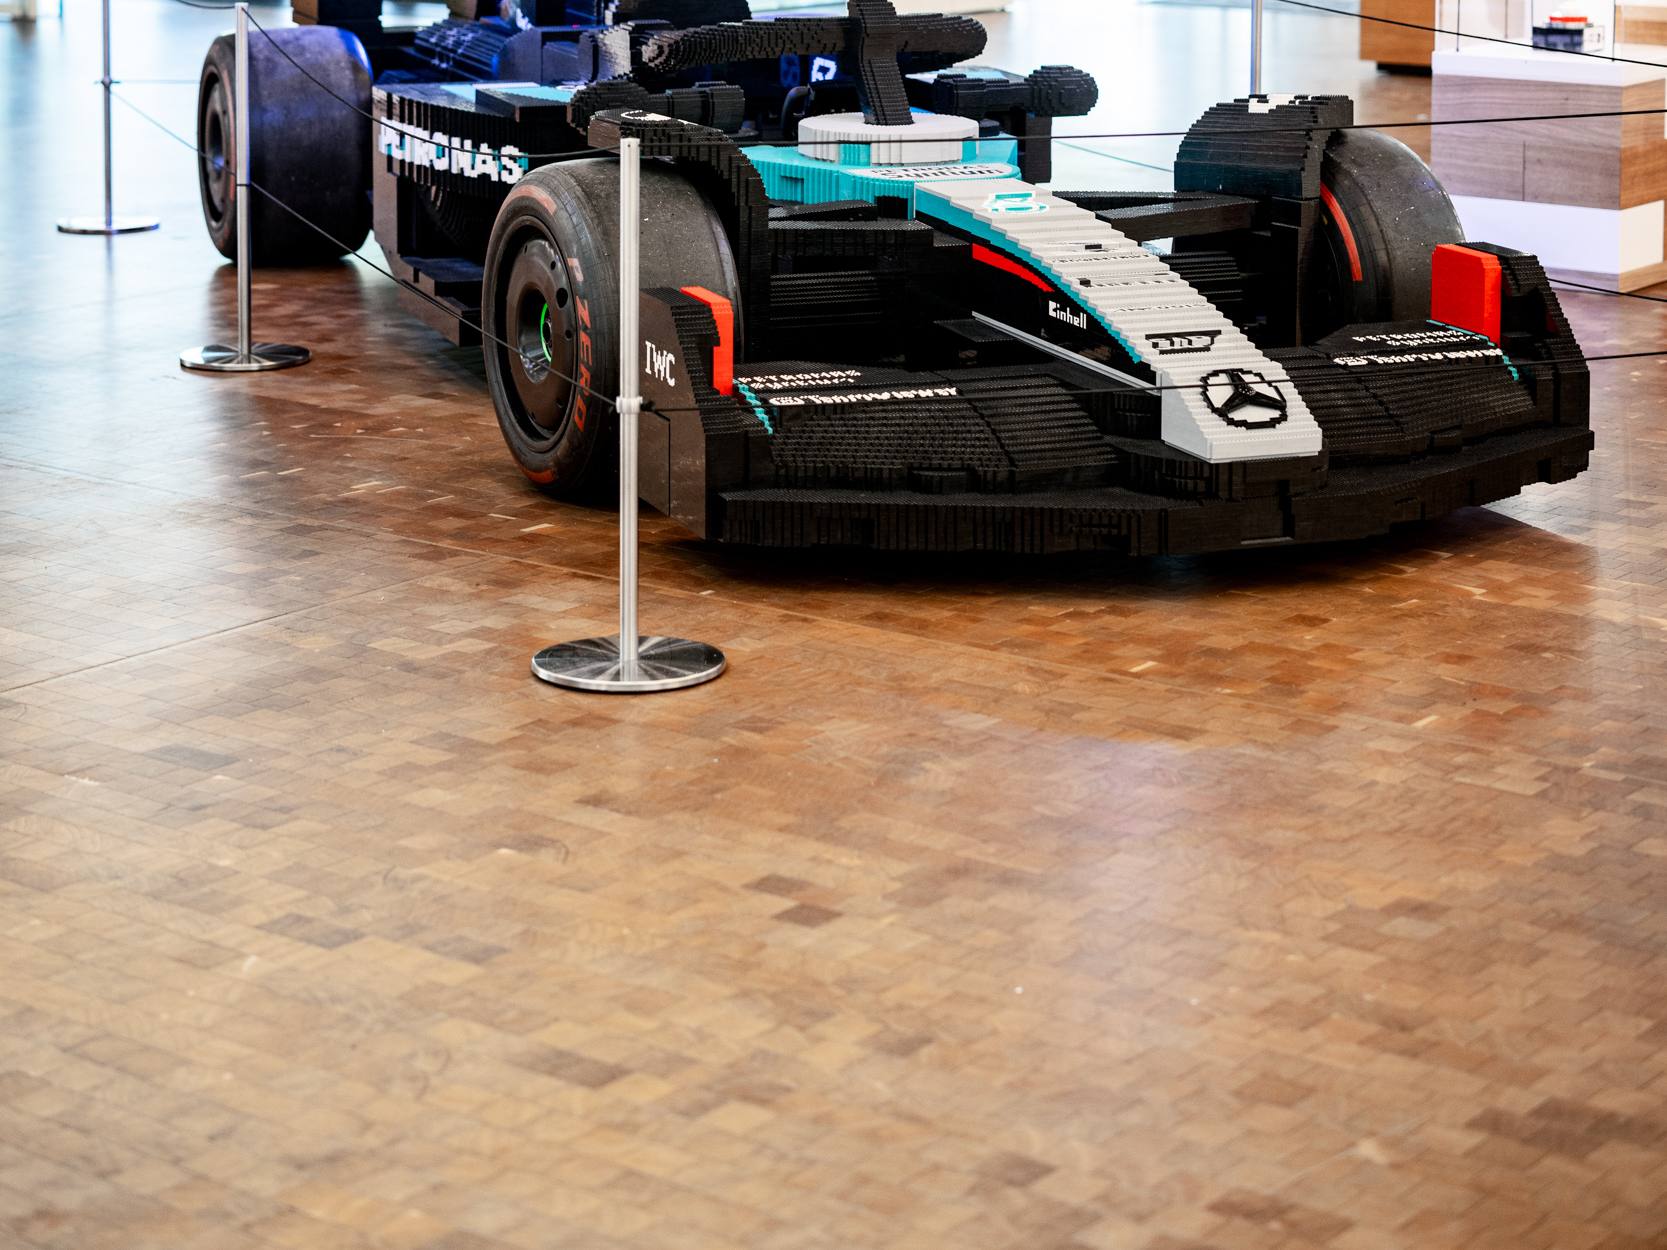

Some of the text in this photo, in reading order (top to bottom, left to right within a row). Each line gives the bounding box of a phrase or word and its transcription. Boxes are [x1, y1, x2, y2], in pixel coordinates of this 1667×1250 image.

[1048, 300, 1087, 330] Einhell
[573, 296, 592, 432] ZERO
[645, 340, 676, 387] IWC
